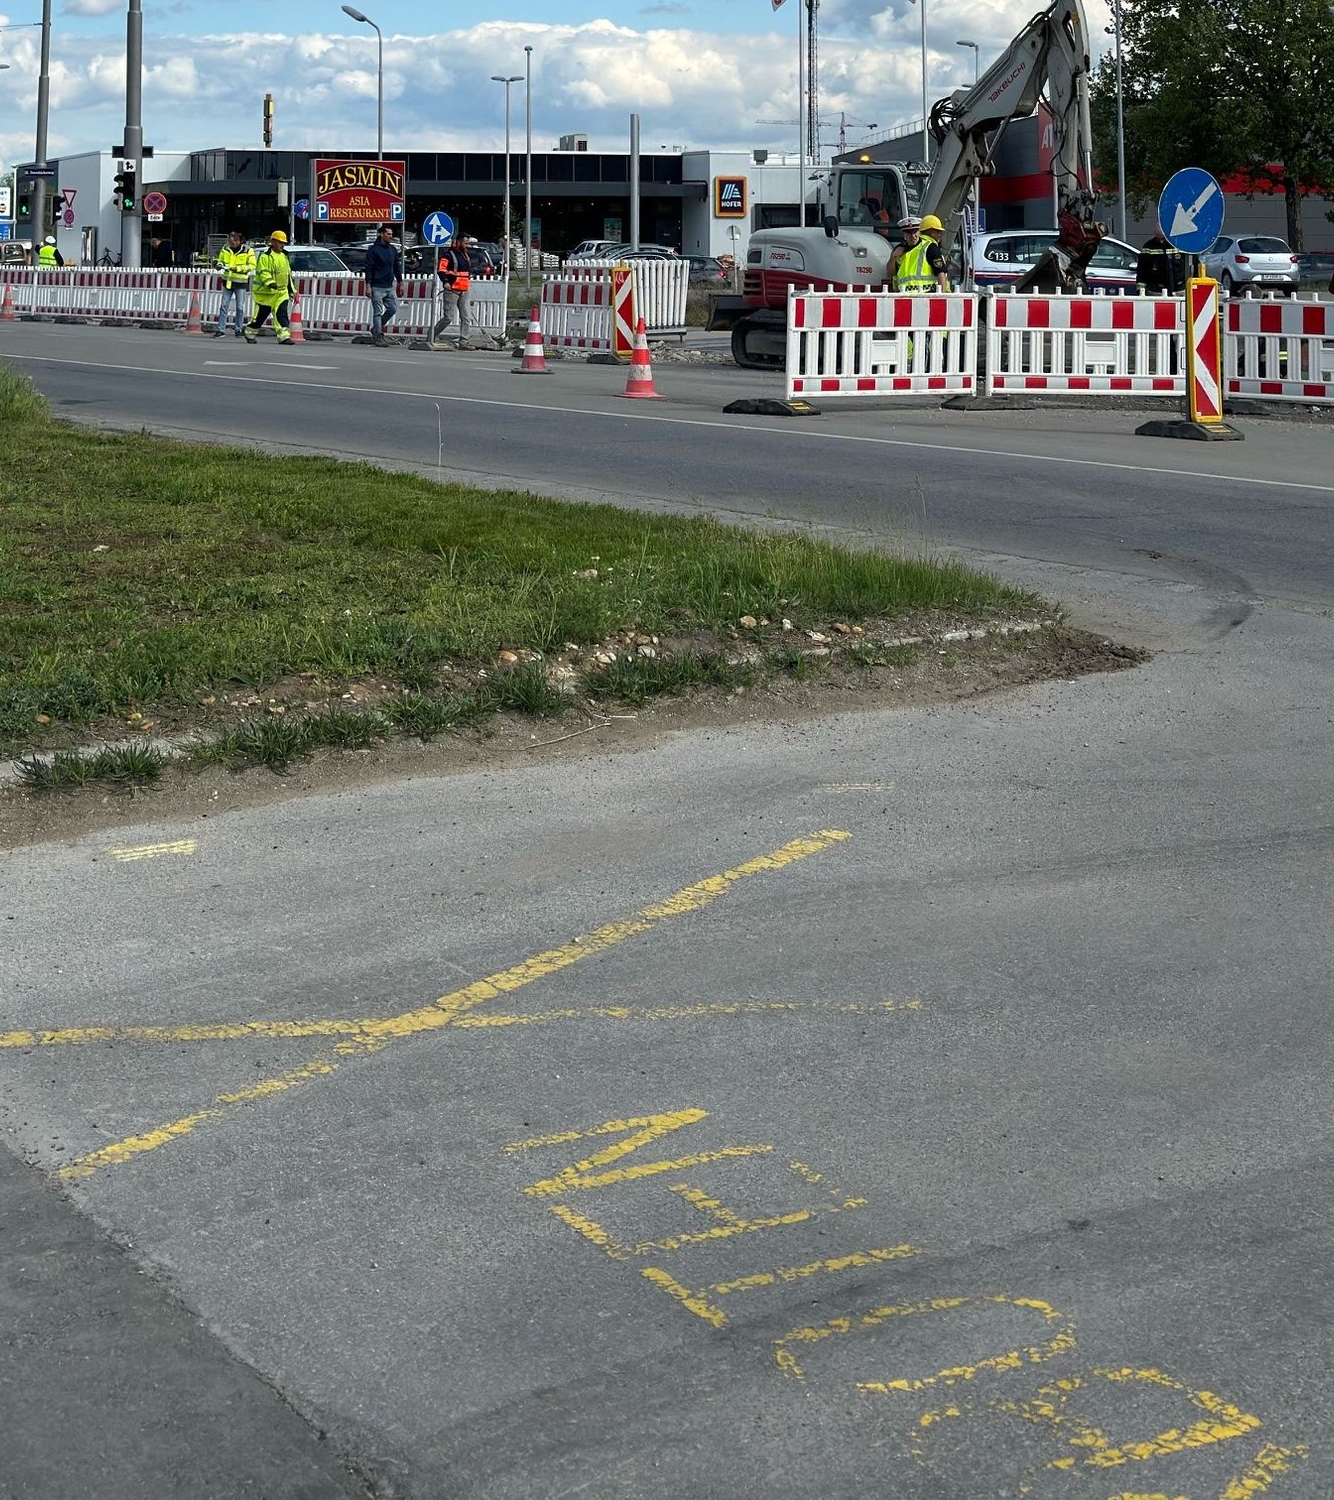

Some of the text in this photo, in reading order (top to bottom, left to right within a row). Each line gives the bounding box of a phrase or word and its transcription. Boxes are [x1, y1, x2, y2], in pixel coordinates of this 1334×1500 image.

[318, 166, 401, 194] JASMIN
[349, 196, 370, 206] ASIA
[330, 207, 390, 218] RESTAURANT
[994, 252, 1009, 261] 133
